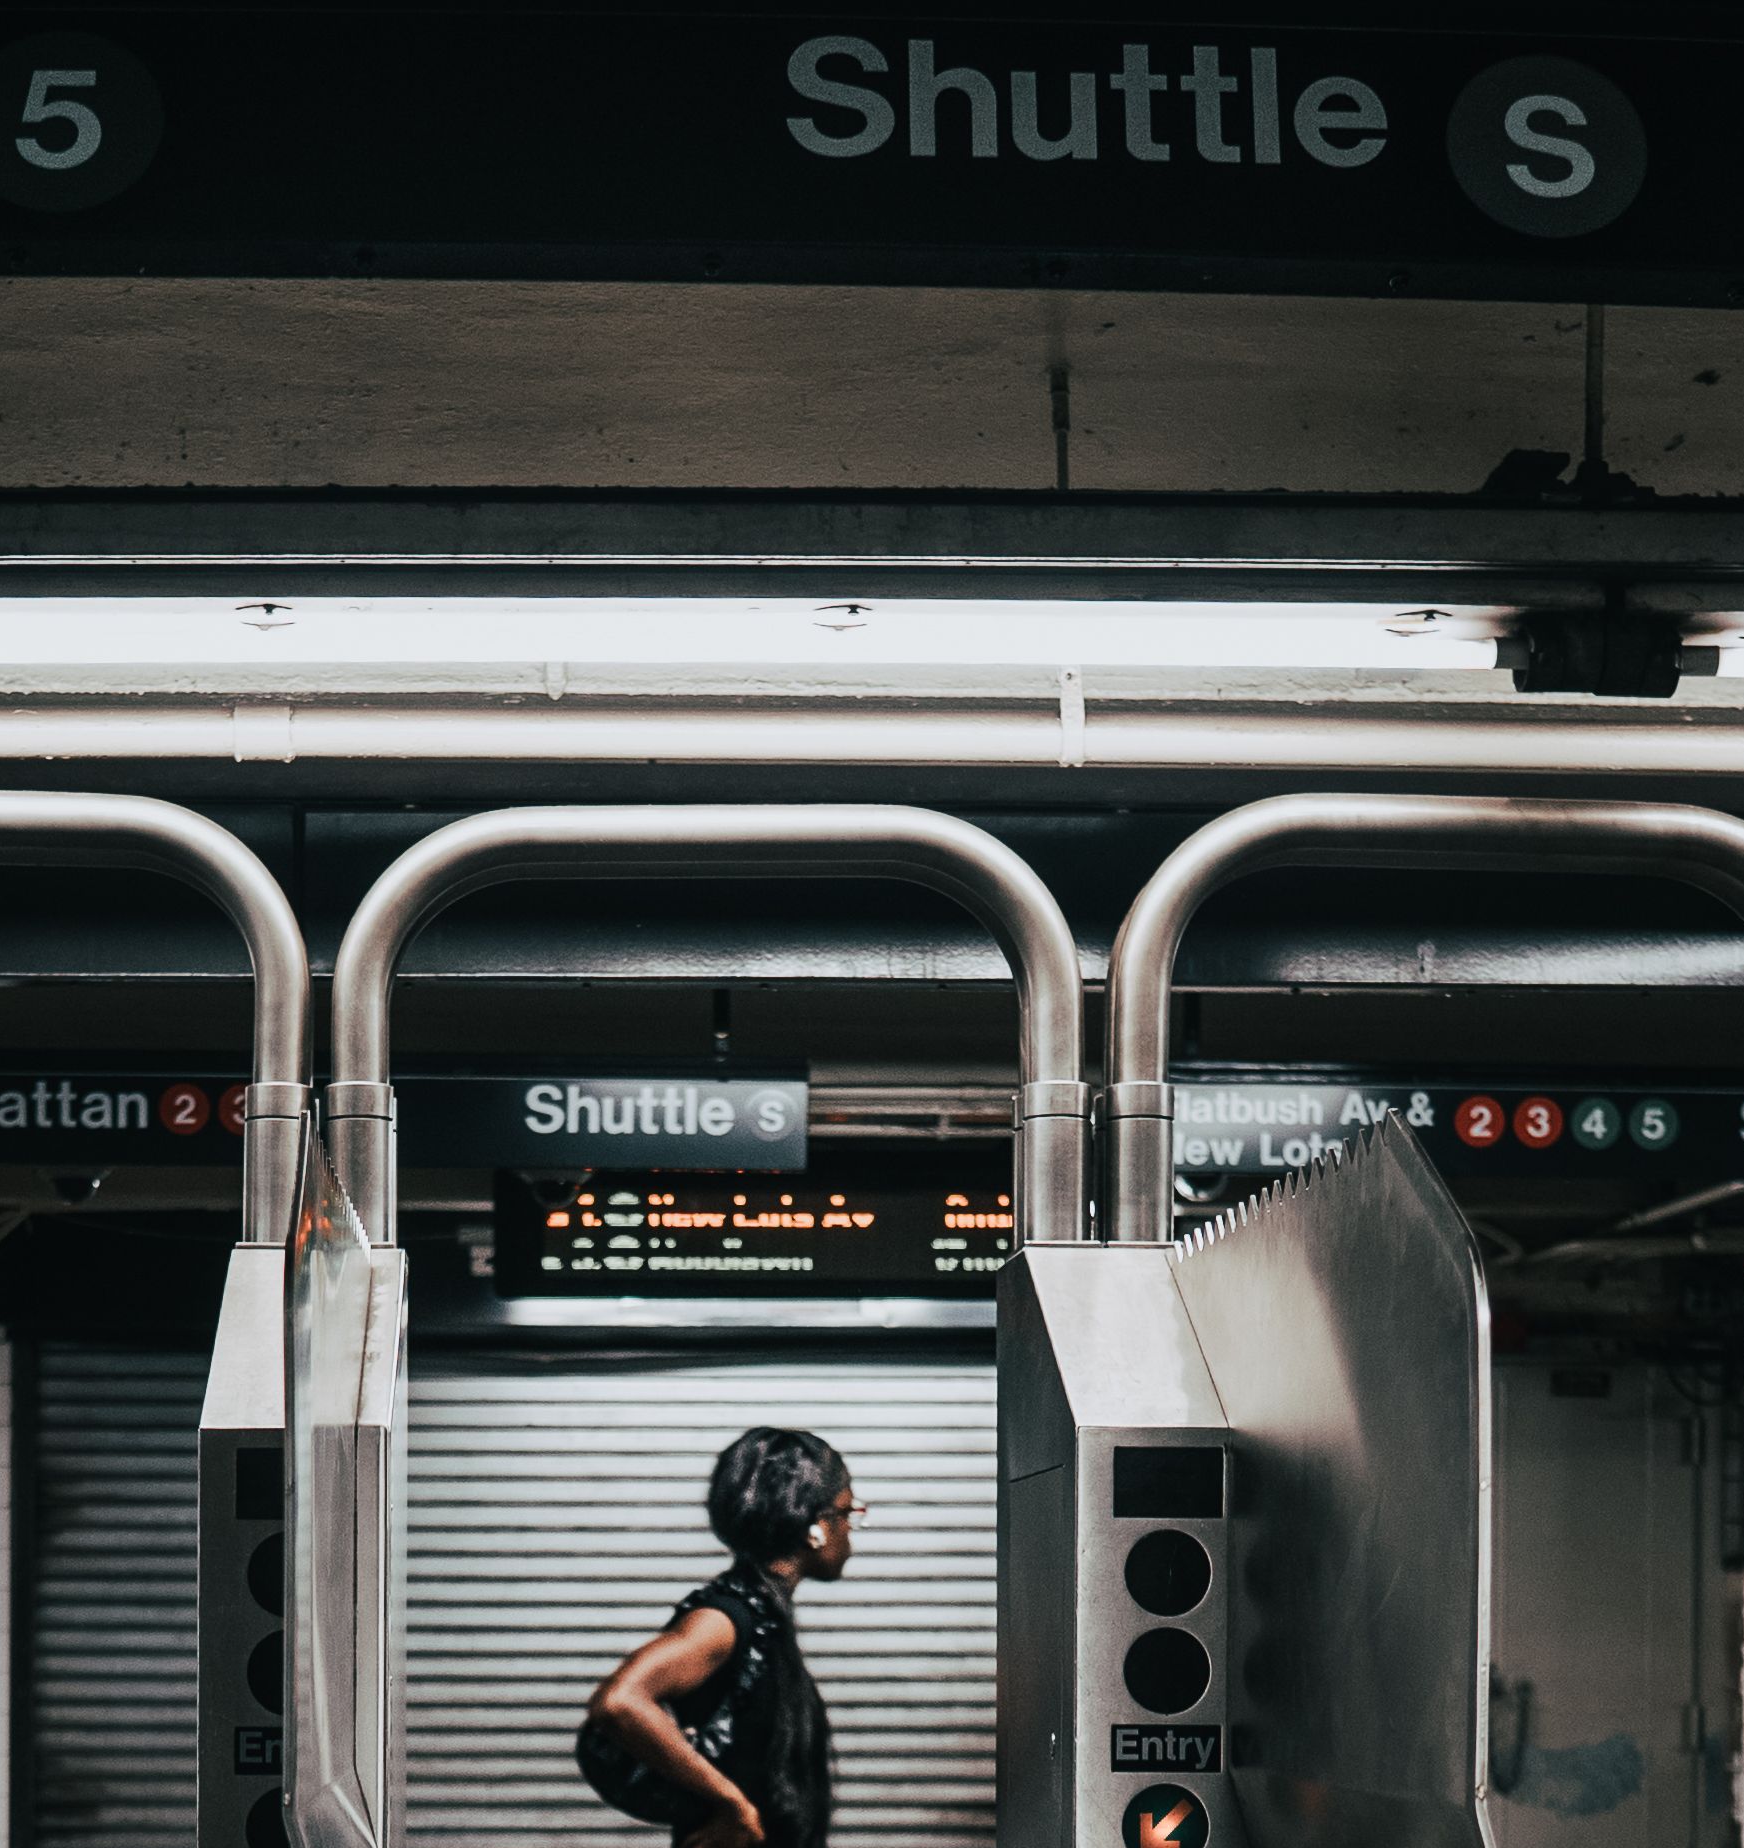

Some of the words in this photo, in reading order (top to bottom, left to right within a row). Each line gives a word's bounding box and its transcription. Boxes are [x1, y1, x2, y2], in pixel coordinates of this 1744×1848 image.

[14, 69, 104, 172] 5
[785, 34, 1389, 169] Shuttle
[1503, 93, 1596, 200] S
[173, 1093, 198, 1126] 2
[524, 1084, 735, 1137] Shuttle
[757, 1100, 786, 1133] S
[1173, 1091, 1324, 1127] latbush
[1339, 1092, 1390, 1126] Av
[1405, 1091, 1435, 1128] &
[1469, 1105, 1493, 1138] 2
[1526, 1105, 1551, 1139] 3
[1581, 1108, 1608, 1140] 4
[1640, 1108, 1666, 1141] 5
[1115, 1727, 1216, 1771] Entry
